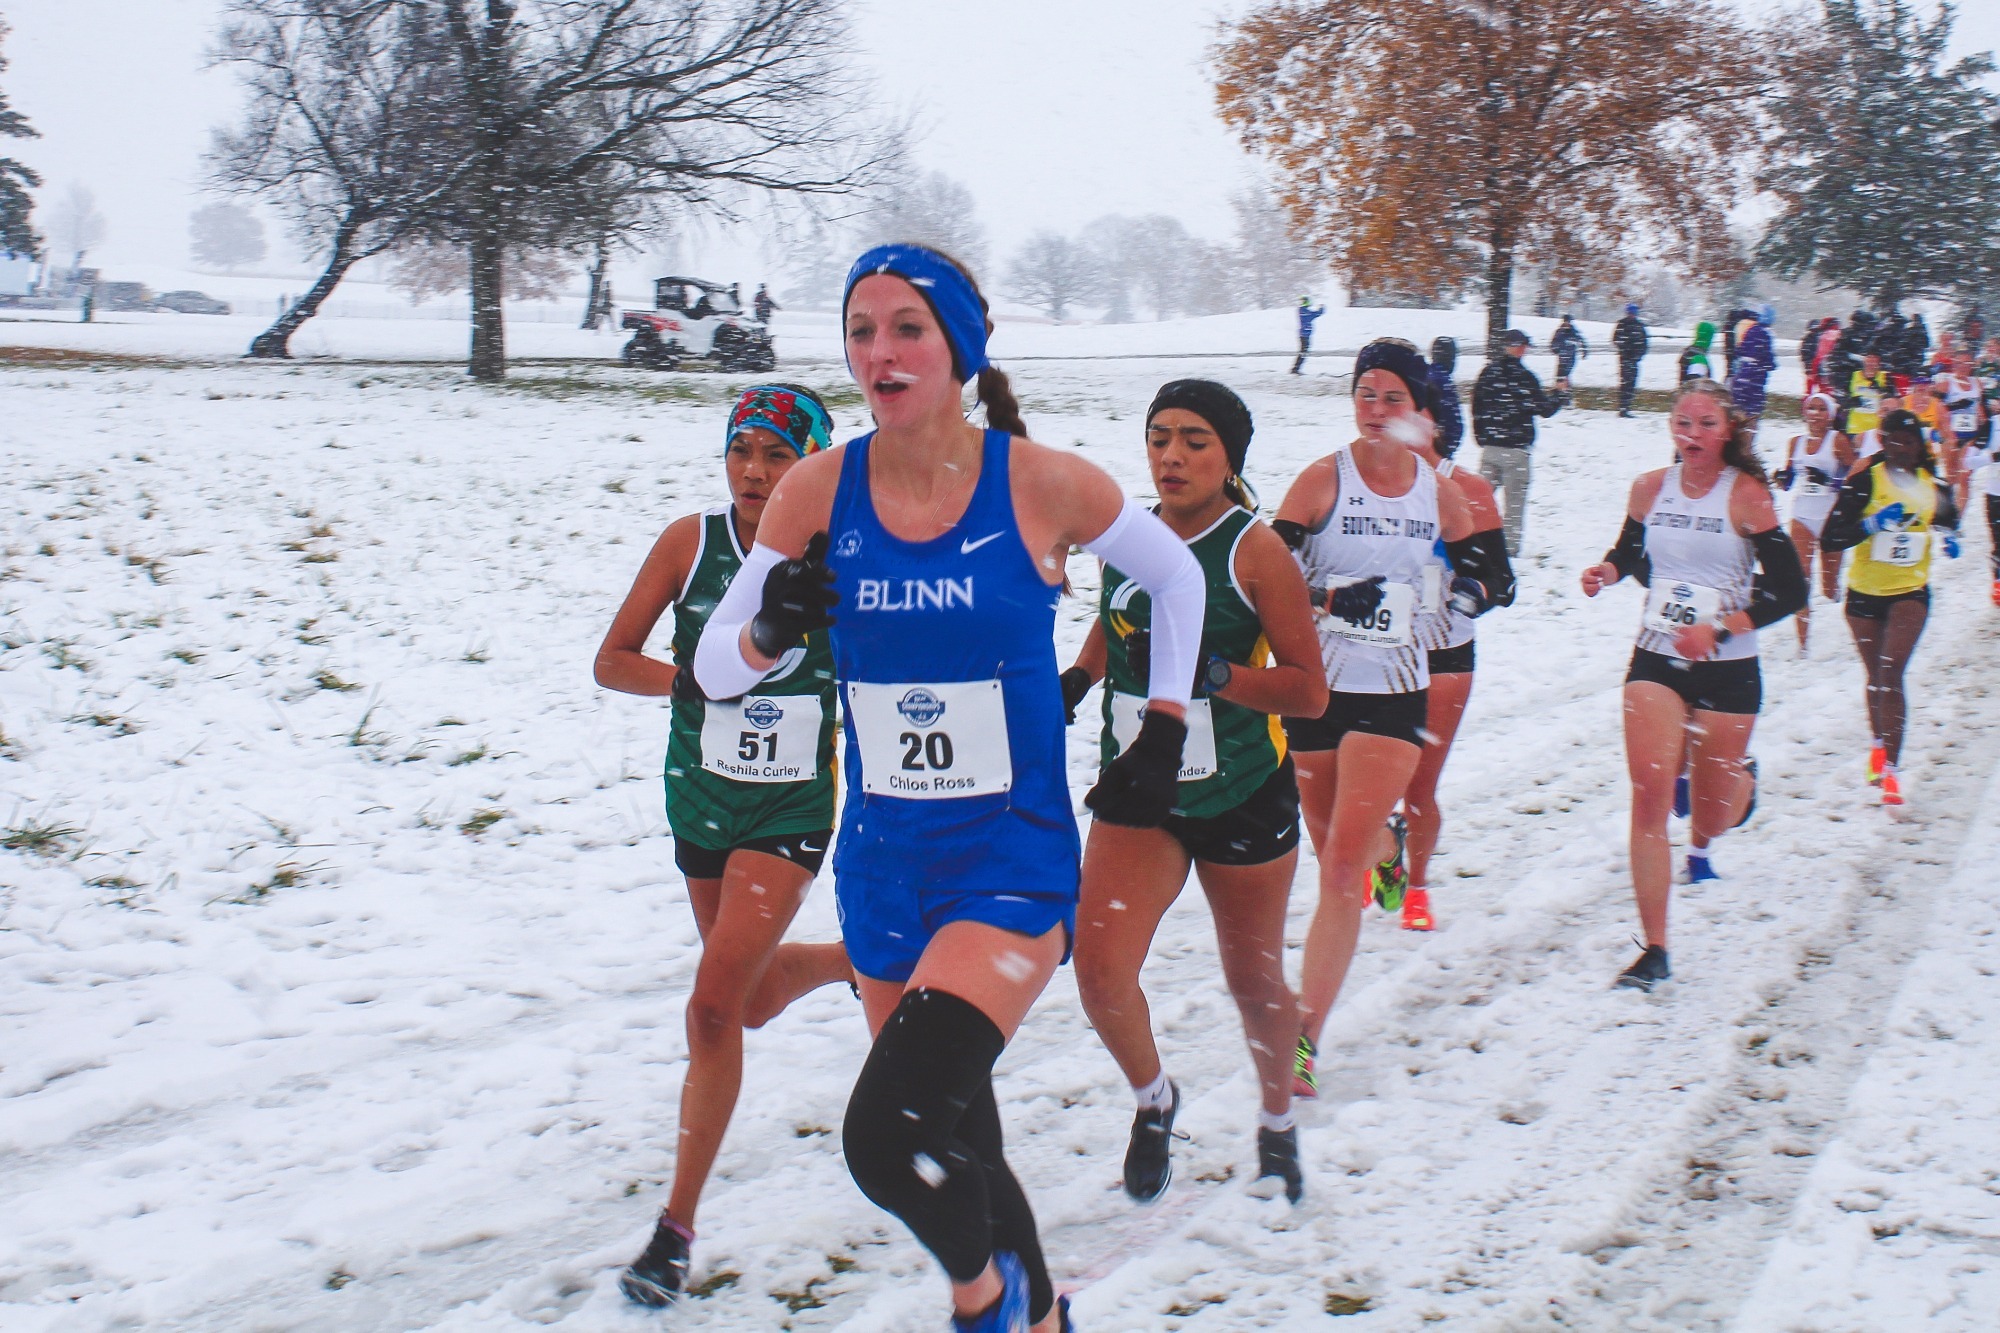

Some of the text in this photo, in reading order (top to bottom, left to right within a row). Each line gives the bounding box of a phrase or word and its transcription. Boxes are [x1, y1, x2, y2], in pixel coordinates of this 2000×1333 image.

[856, 576, 974, 612] BLINN
[1662, 602, 1696, 625] 406
[738, 731, 779, 762] 51
[900, 732, 954, 771] 20
[763, 766, 800, 778] Curley
[889, 775, 976, 791] Chloe Ross
